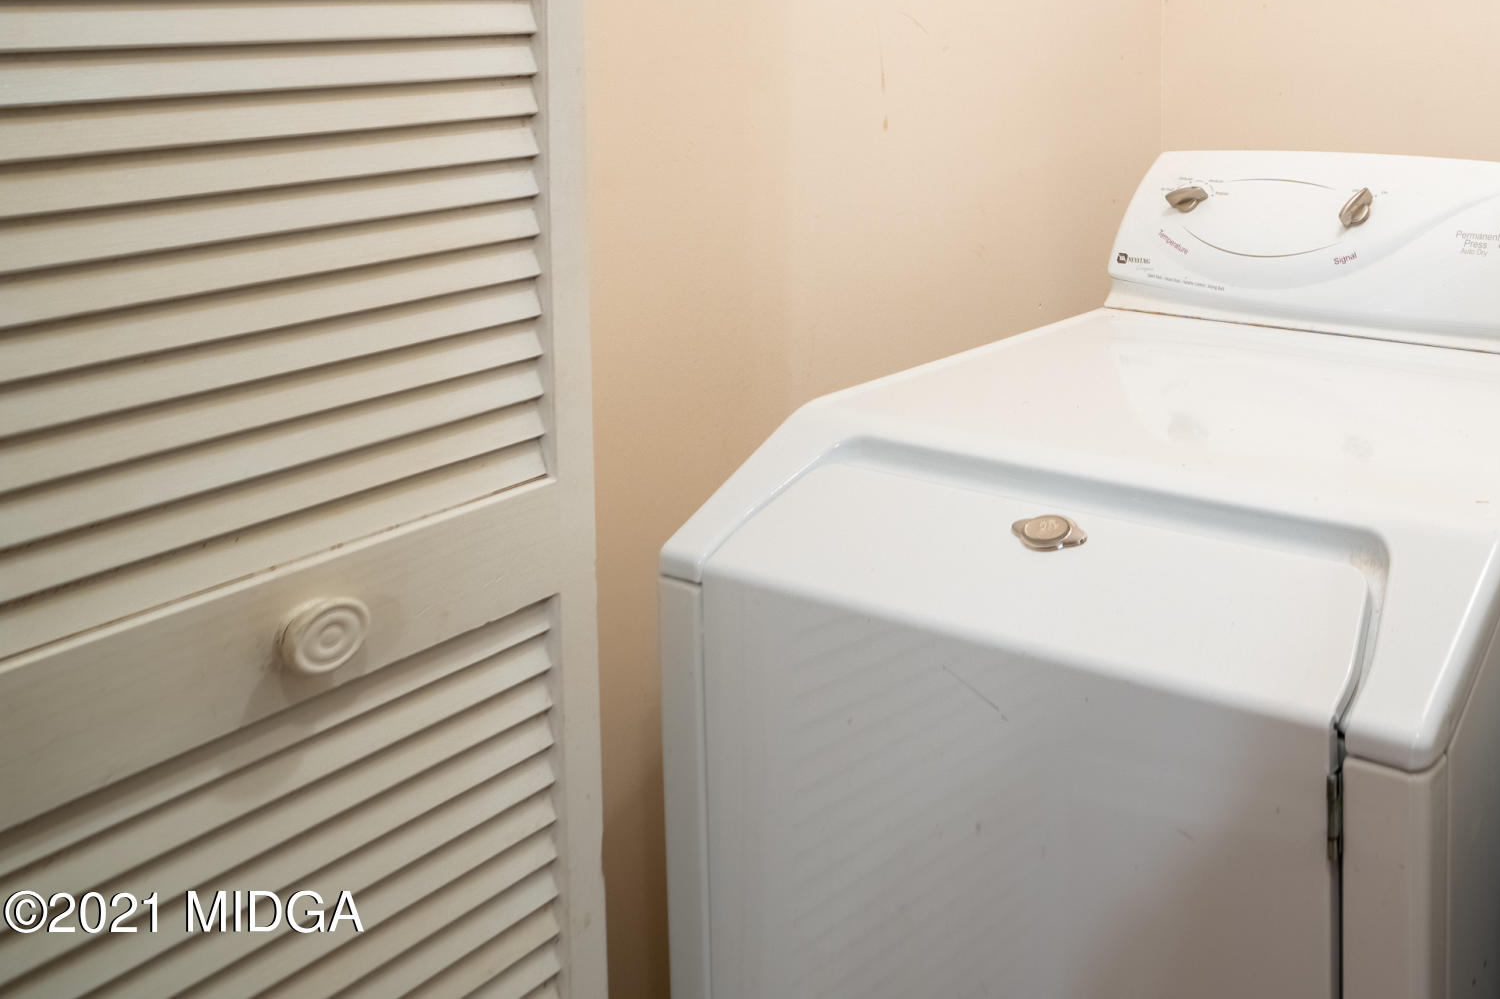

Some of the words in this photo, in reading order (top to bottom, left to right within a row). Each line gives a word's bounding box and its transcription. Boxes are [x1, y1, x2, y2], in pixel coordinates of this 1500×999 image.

[1456, 230, 1500, 241] Permanent
[1158, 229, 1189, 255] Temperature
[1464, 240, 1488, 249] Press
[1334, 252, 1357, 265] Signal
[1476, 249, 1488, 257] Dry
